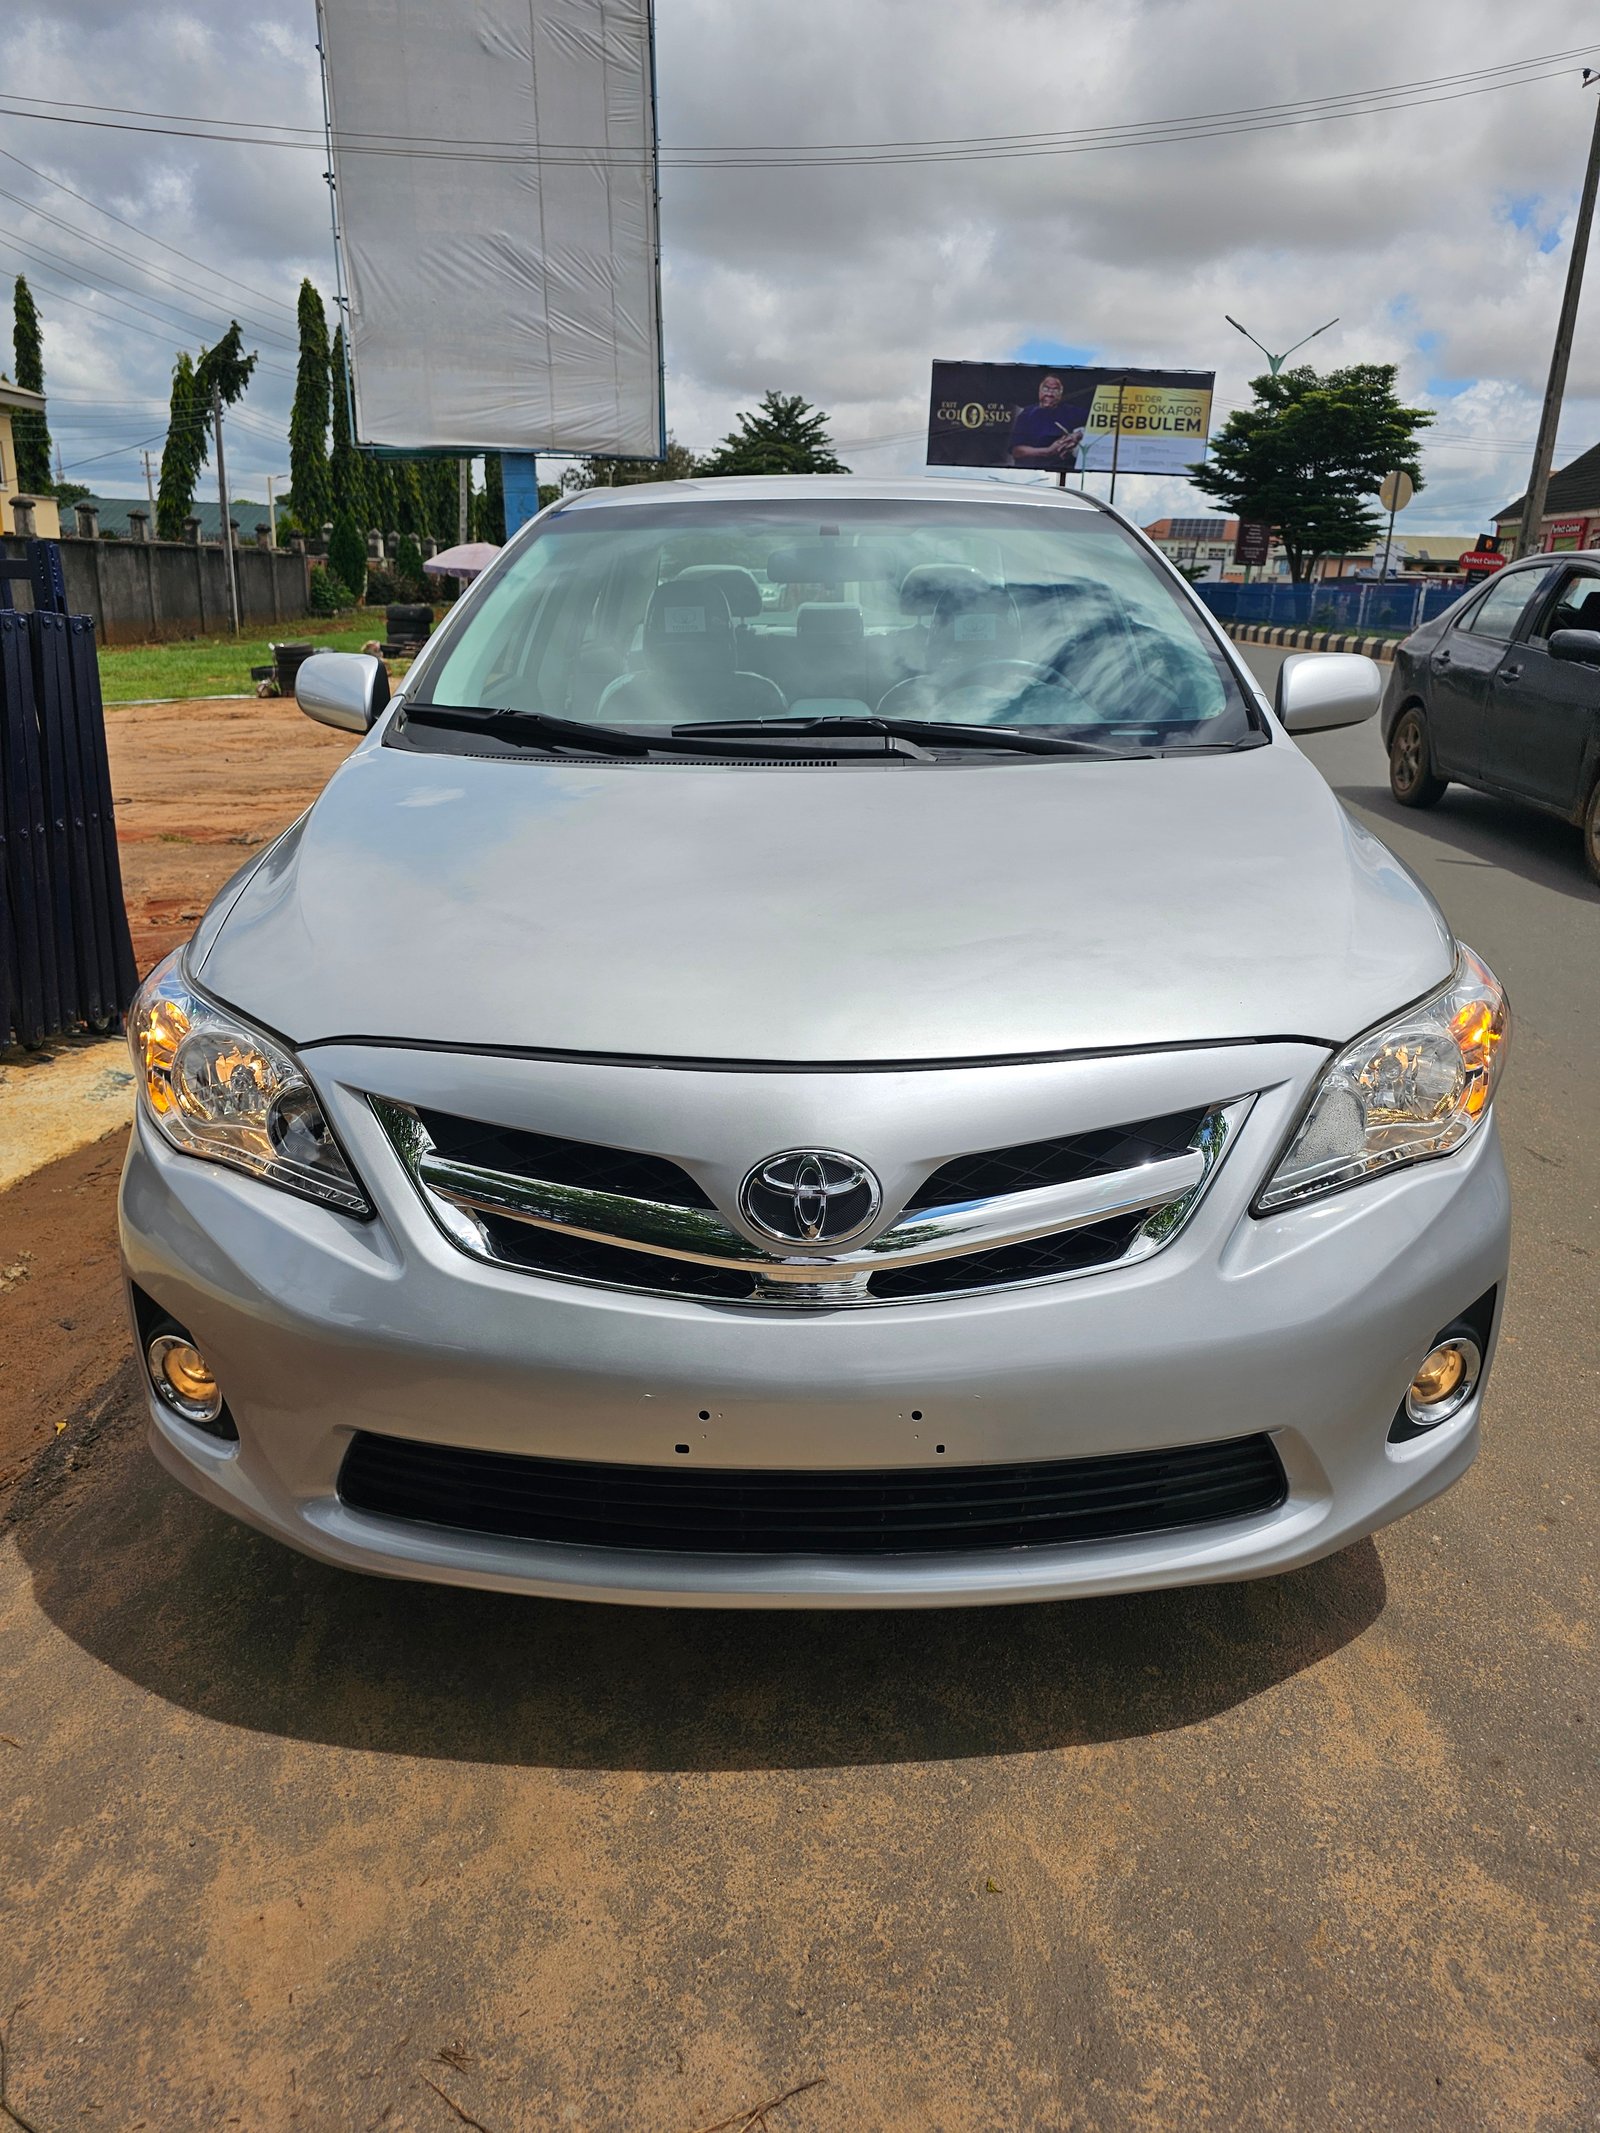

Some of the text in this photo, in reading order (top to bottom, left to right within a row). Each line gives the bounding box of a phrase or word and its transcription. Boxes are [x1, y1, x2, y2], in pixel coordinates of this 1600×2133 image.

[941, 401, 957, 409] EXIT
[1135, 394, 1163, 403] ELDER
[1093, 402, 1202, 416] GILBERT OKAFOR
[1090, 414, 1201, 432] IBEGBULEM
[1463, 554, 1503, 567] Perfect Cuisine
